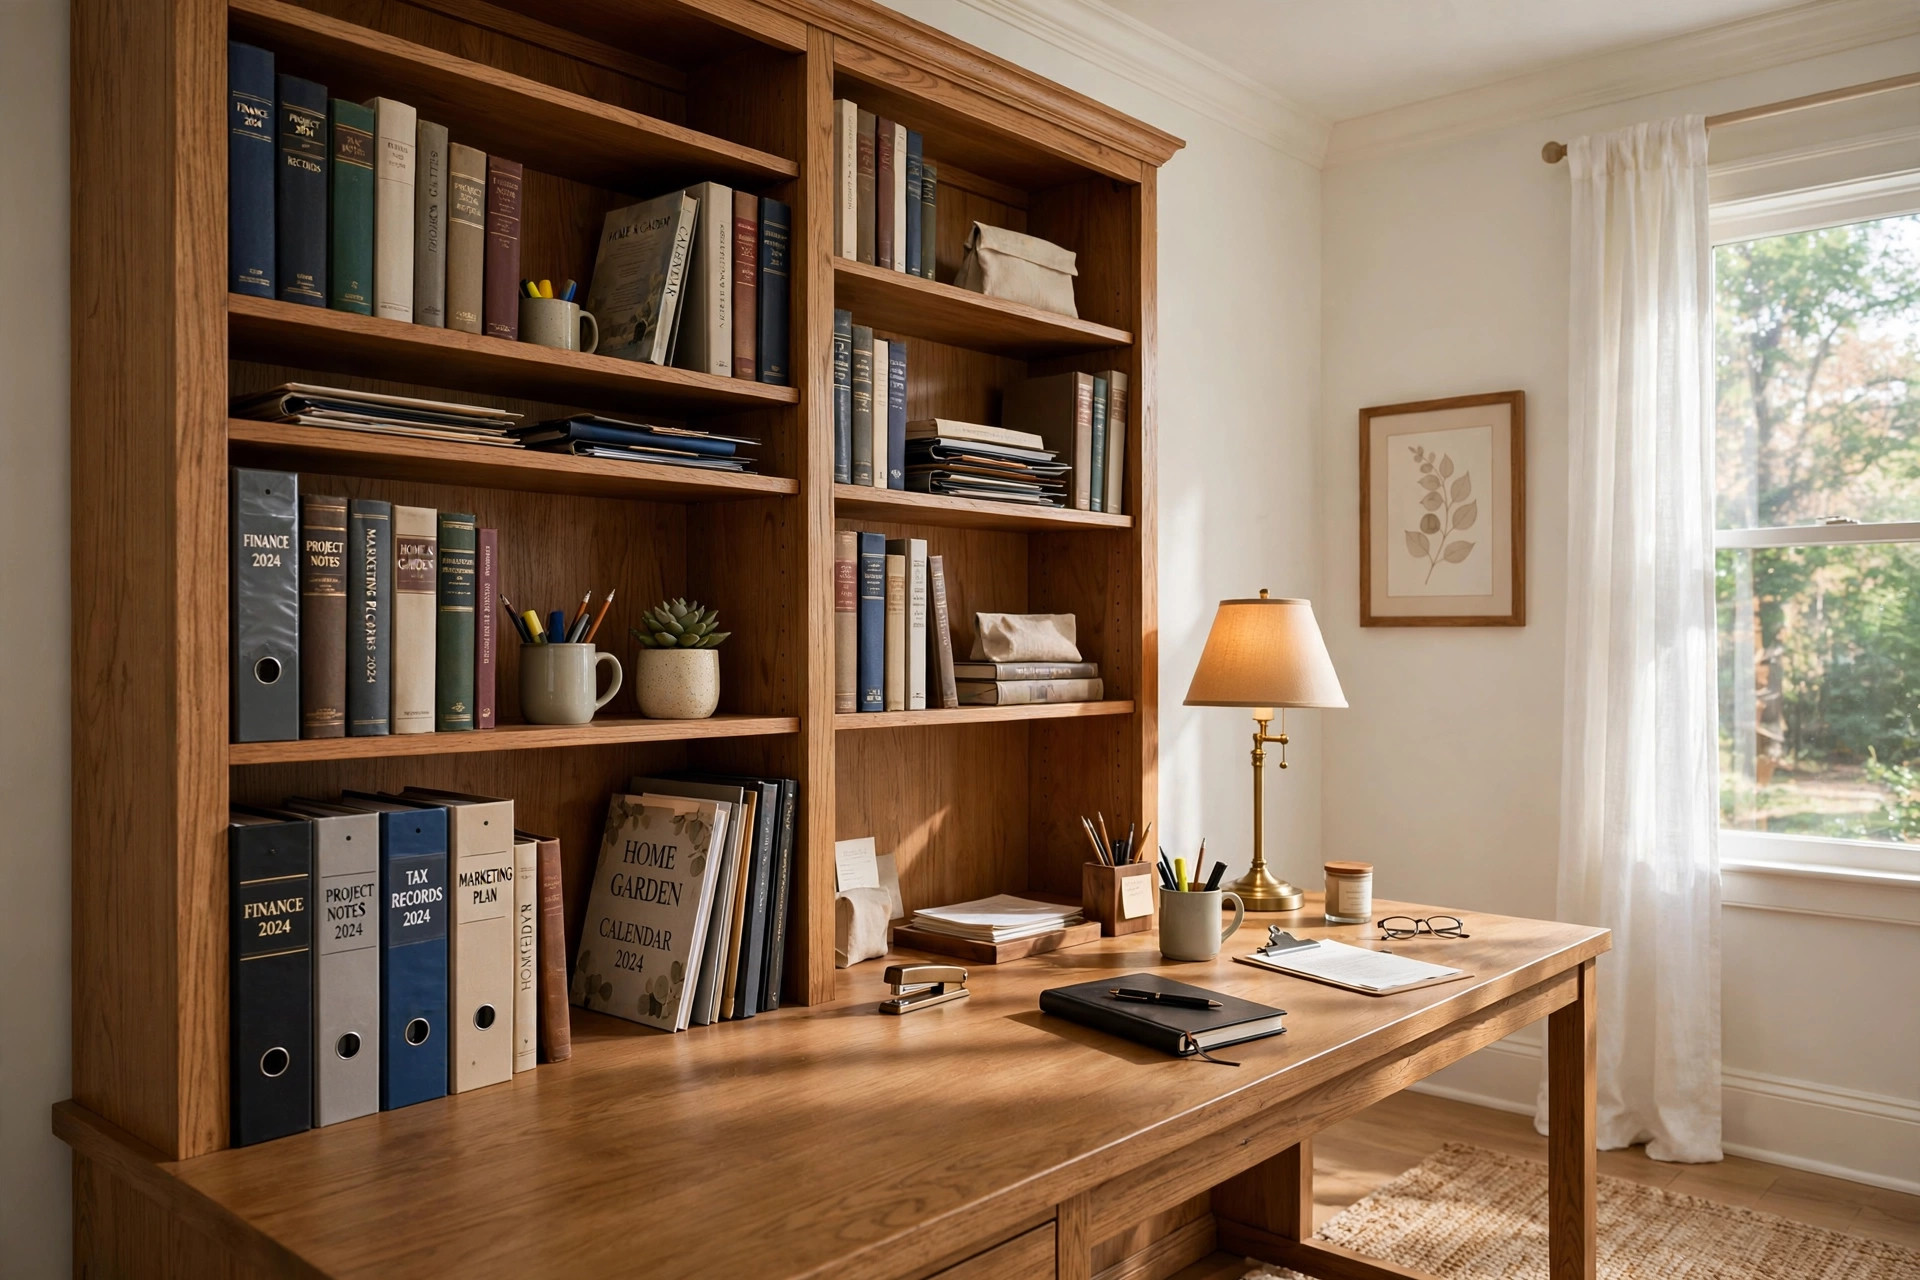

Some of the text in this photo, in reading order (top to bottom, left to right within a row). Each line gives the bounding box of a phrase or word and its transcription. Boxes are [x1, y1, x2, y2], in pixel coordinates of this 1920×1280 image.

[243, 533, 290, 549] FINANCE
[305, 540, 344, 555] PROJECT
[252, 553, 281, 568] 2024
[310, 555, 340, 568] NOTES
[365, 528, 377, 596] MARKETING
[366, 655, 377, 684] 2024
[623, 839, 678, 870] HOME
[405, 868, 430, 886] TAX
[459, 866, 513, 887] MARKETING
[325, 883, 375, 904] PROJECT
[391, 886, 443, 909] RECORDS
[473, 887, 498, 905] PLAN
[610, 873, 684, 908] GARDEN
[243, 896, 305, 920] FINANCE
[327, 902, 366, 922] NOTES
[403, 908, 431, 928] 2024
[258, 919, 292, 938] 2024
[334, 923, 364, 940] 2024
[599, 917, 673, 952] CALENDAR
[614, 949, 645, 973] 2024
